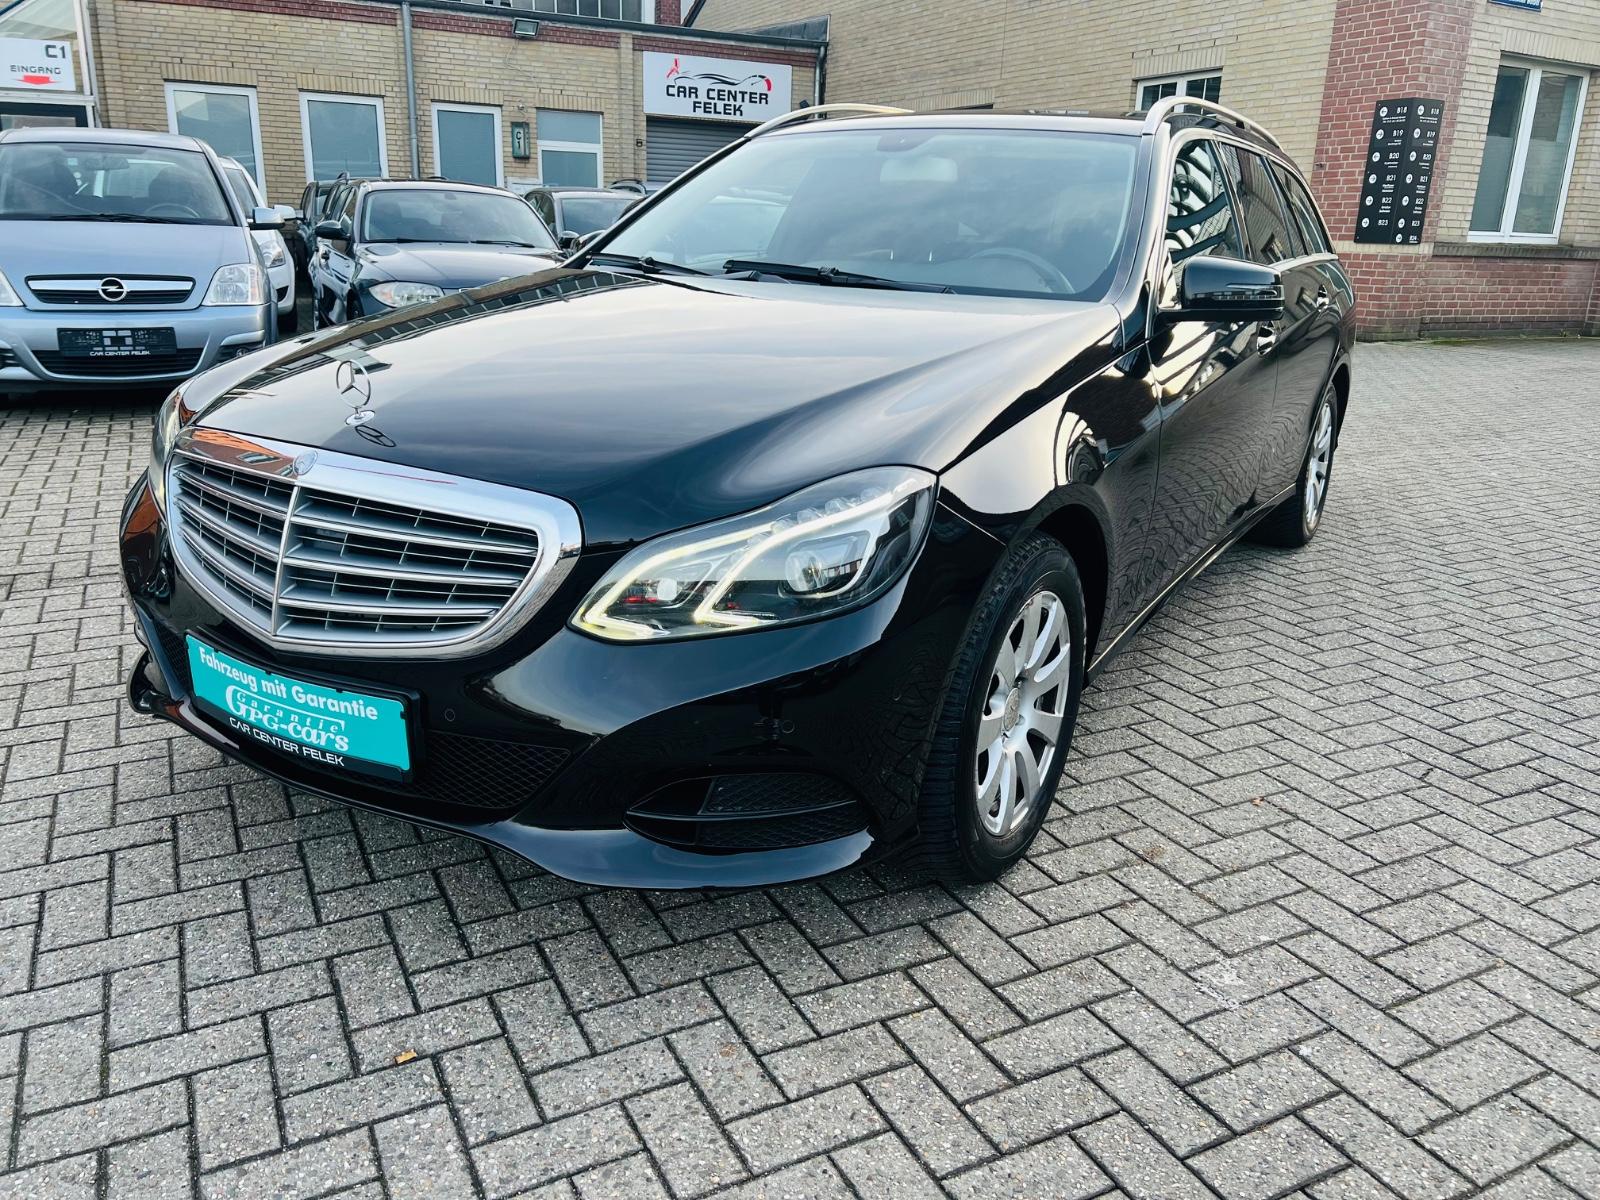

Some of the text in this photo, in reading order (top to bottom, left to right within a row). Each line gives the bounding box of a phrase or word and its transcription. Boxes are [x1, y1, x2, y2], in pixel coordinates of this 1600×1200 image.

[45, 44, 66, 59] C1
[10, 64, 62, 75] EINGANG
[666, 84, 769, 105] CAR CENTER
[692, 101, 743, 116] FELEK
[1393, 129, 1404, 137] B19
[199, 646, 379, 720] Fahrzeug mit Garantie
[236, 692, 338, 733] Garantie
[229, 716, 345, 767] CAR CENTER FELEK
